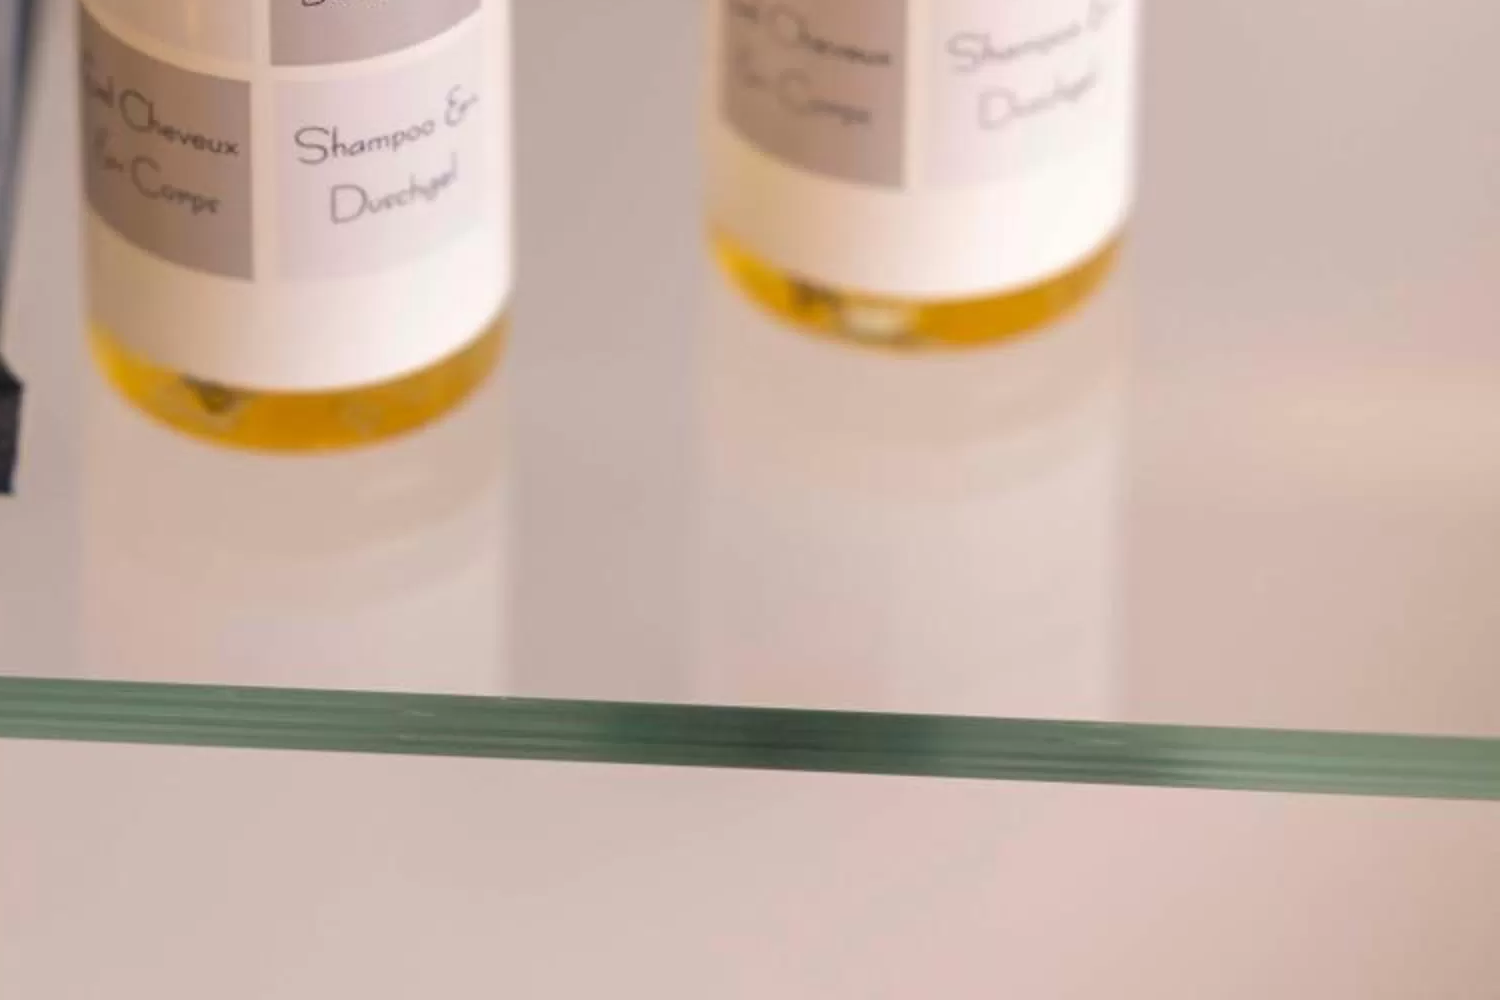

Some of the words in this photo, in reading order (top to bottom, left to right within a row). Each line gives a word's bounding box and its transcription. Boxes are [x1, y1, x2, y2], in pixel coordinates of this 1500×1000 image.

[119, 88, 240, 156] Cheveux
[294, 125, 436, 166] Shampoo
[130, 154, 220, 216] Corps
